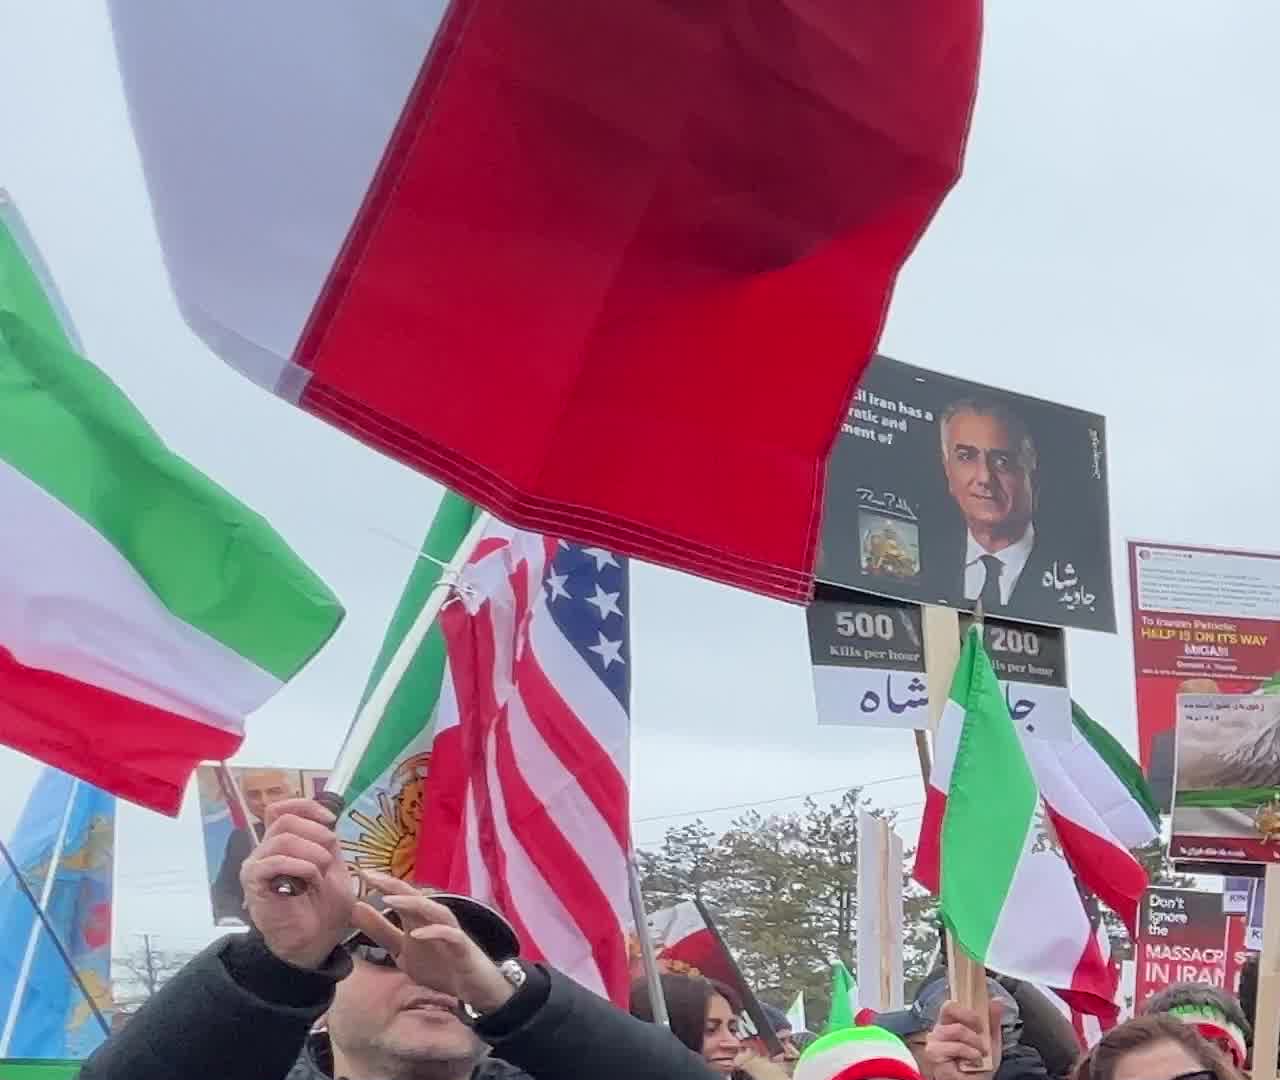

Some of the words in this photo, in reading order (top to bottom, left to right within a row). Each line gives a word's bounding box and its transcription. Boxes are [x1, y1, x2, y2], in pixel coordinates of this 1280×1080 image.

[836, 611, 894, 641] 500
[990, 628, 1039, 654] 200
[1240, 635, 1267, 647] WAY
[1146, 944, 1224, 964] MASSACR
[1145, 962, 1170, 984] IN
